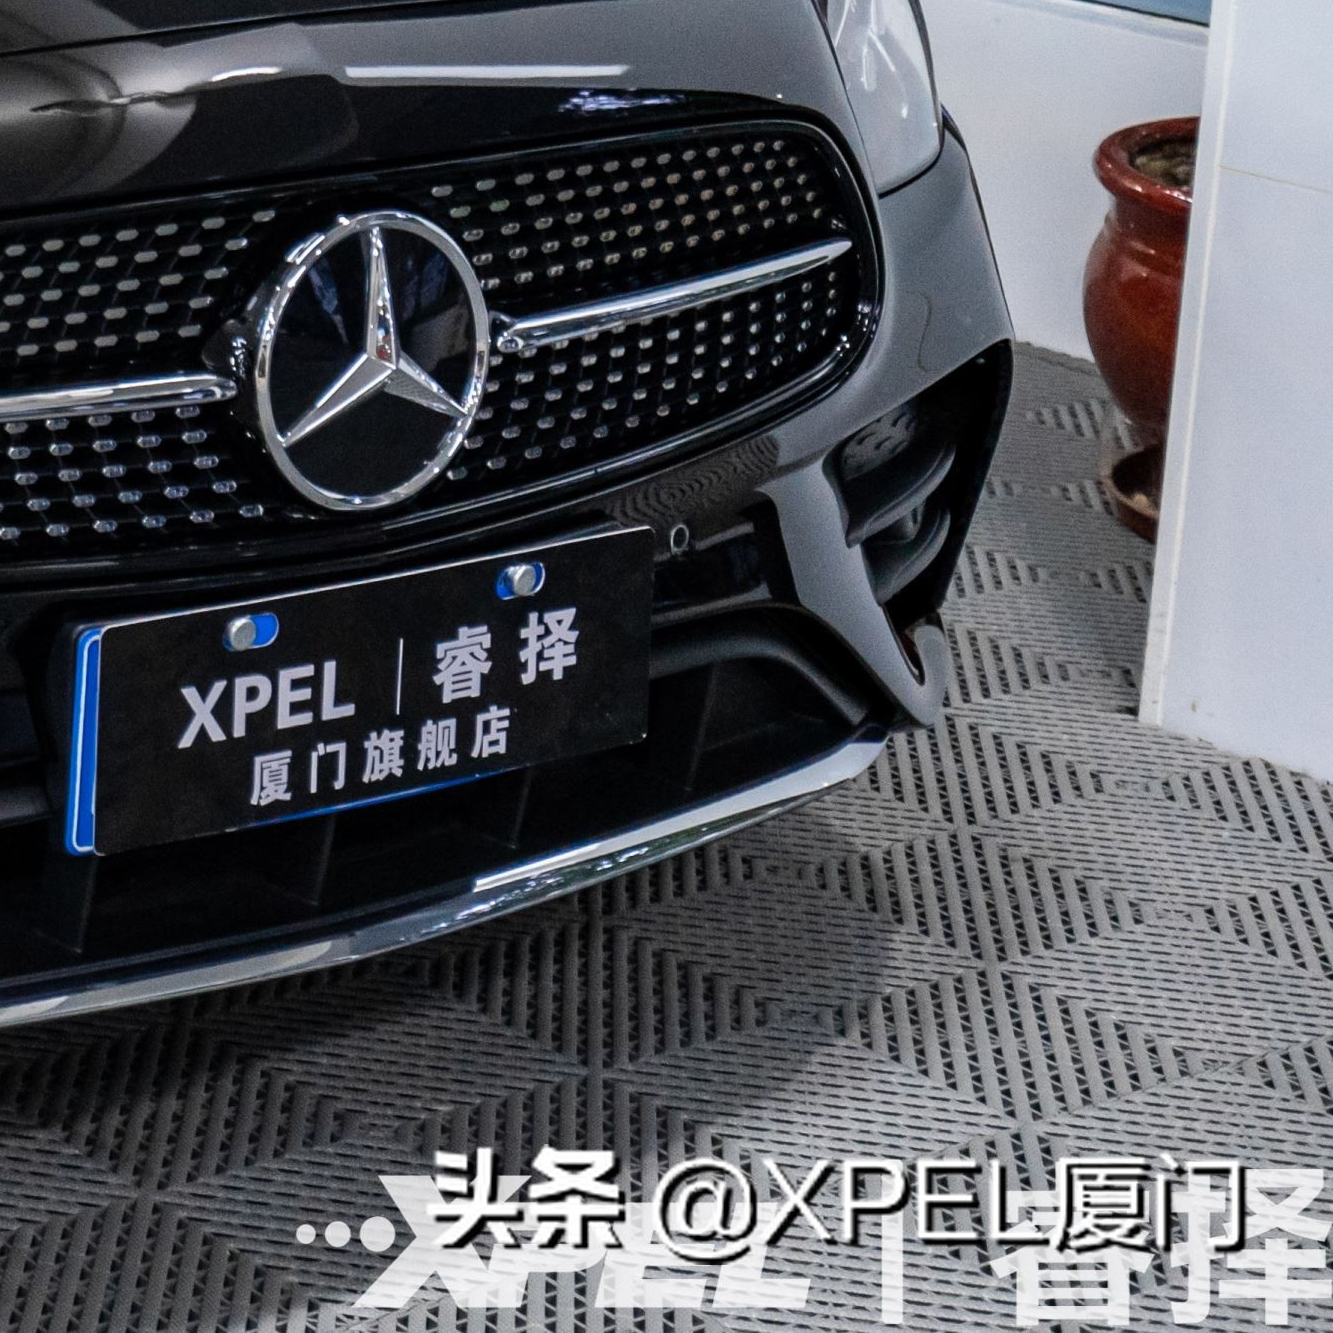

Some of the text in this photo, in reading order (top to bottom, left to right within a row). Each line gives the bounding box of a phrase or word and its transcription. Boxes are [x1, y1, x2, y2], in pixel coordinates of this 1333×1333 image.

[177, 606, 581, 750] XPEL 睿择
[249, 705, 512, 808] 厦门旗舰店
